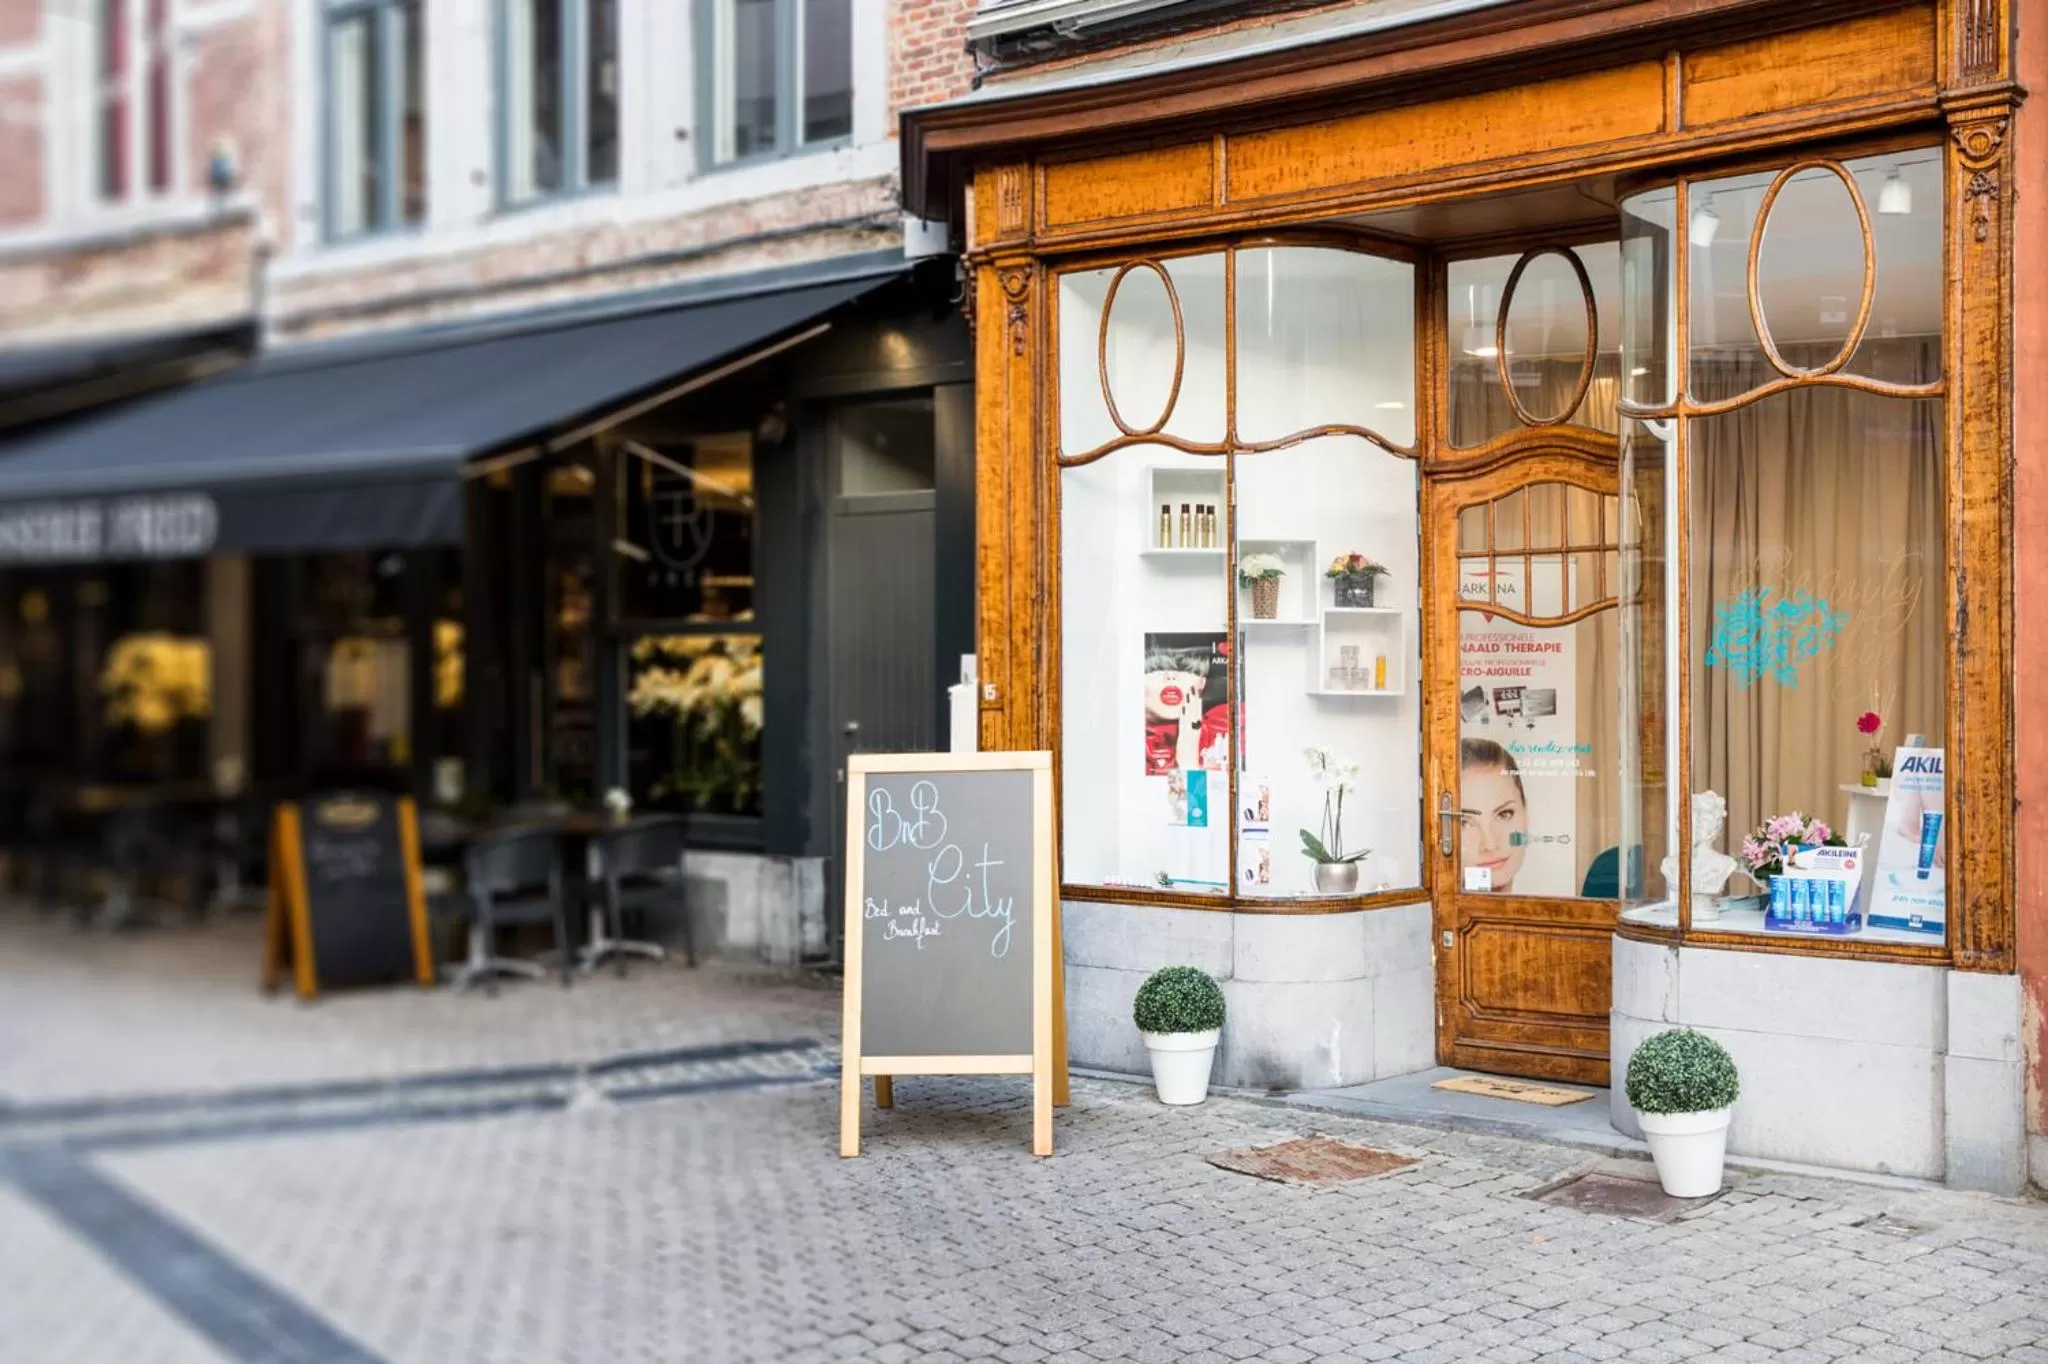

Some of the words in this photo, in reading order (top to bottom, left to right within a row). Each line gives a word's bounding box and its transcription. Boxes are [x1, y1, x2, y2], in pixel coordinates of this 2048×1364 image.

[1462, 582, 1517, 595] ARKNA
[1505, 642, 1563, 654] THERAPIE
[868, 780, 948, 851] BnB
[864, 897, 892, 919] Bed
[899, 899, 923, 916] and
[928, 842, 1017, 958] City
[883, 917, 943, 950] Breakfast
